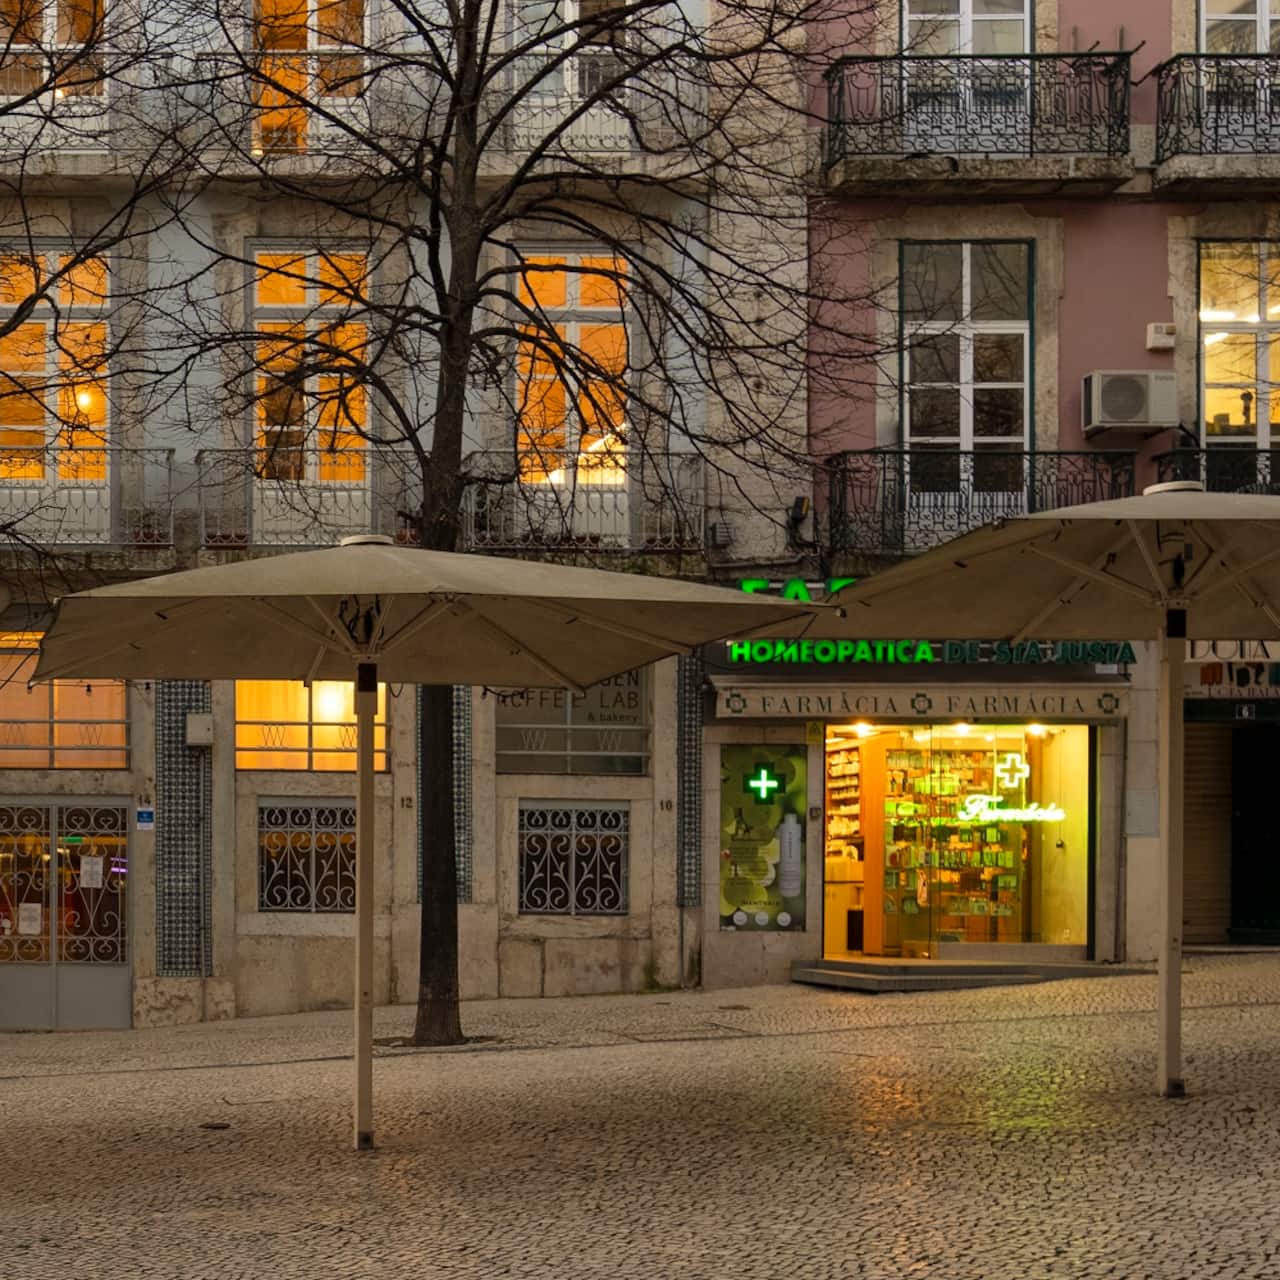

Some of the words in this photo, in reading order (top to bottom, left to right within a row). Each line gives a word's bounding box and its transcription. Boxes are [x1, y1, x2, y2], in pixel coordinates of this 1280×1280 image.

[730, 639, 934, 663] HOMEOPATICA
[944, 639, 980, 663] DE
[1055, 640, 1138, 664] JUSTA
[600, 690, 640, 710] LAB
[761, 692, 898, 714] FARMÁCIA
[947, 692, 1086, 713] FARMÁCIA
[401, 796, 413, 809] 12
[660, 800, 673, 811] 10
